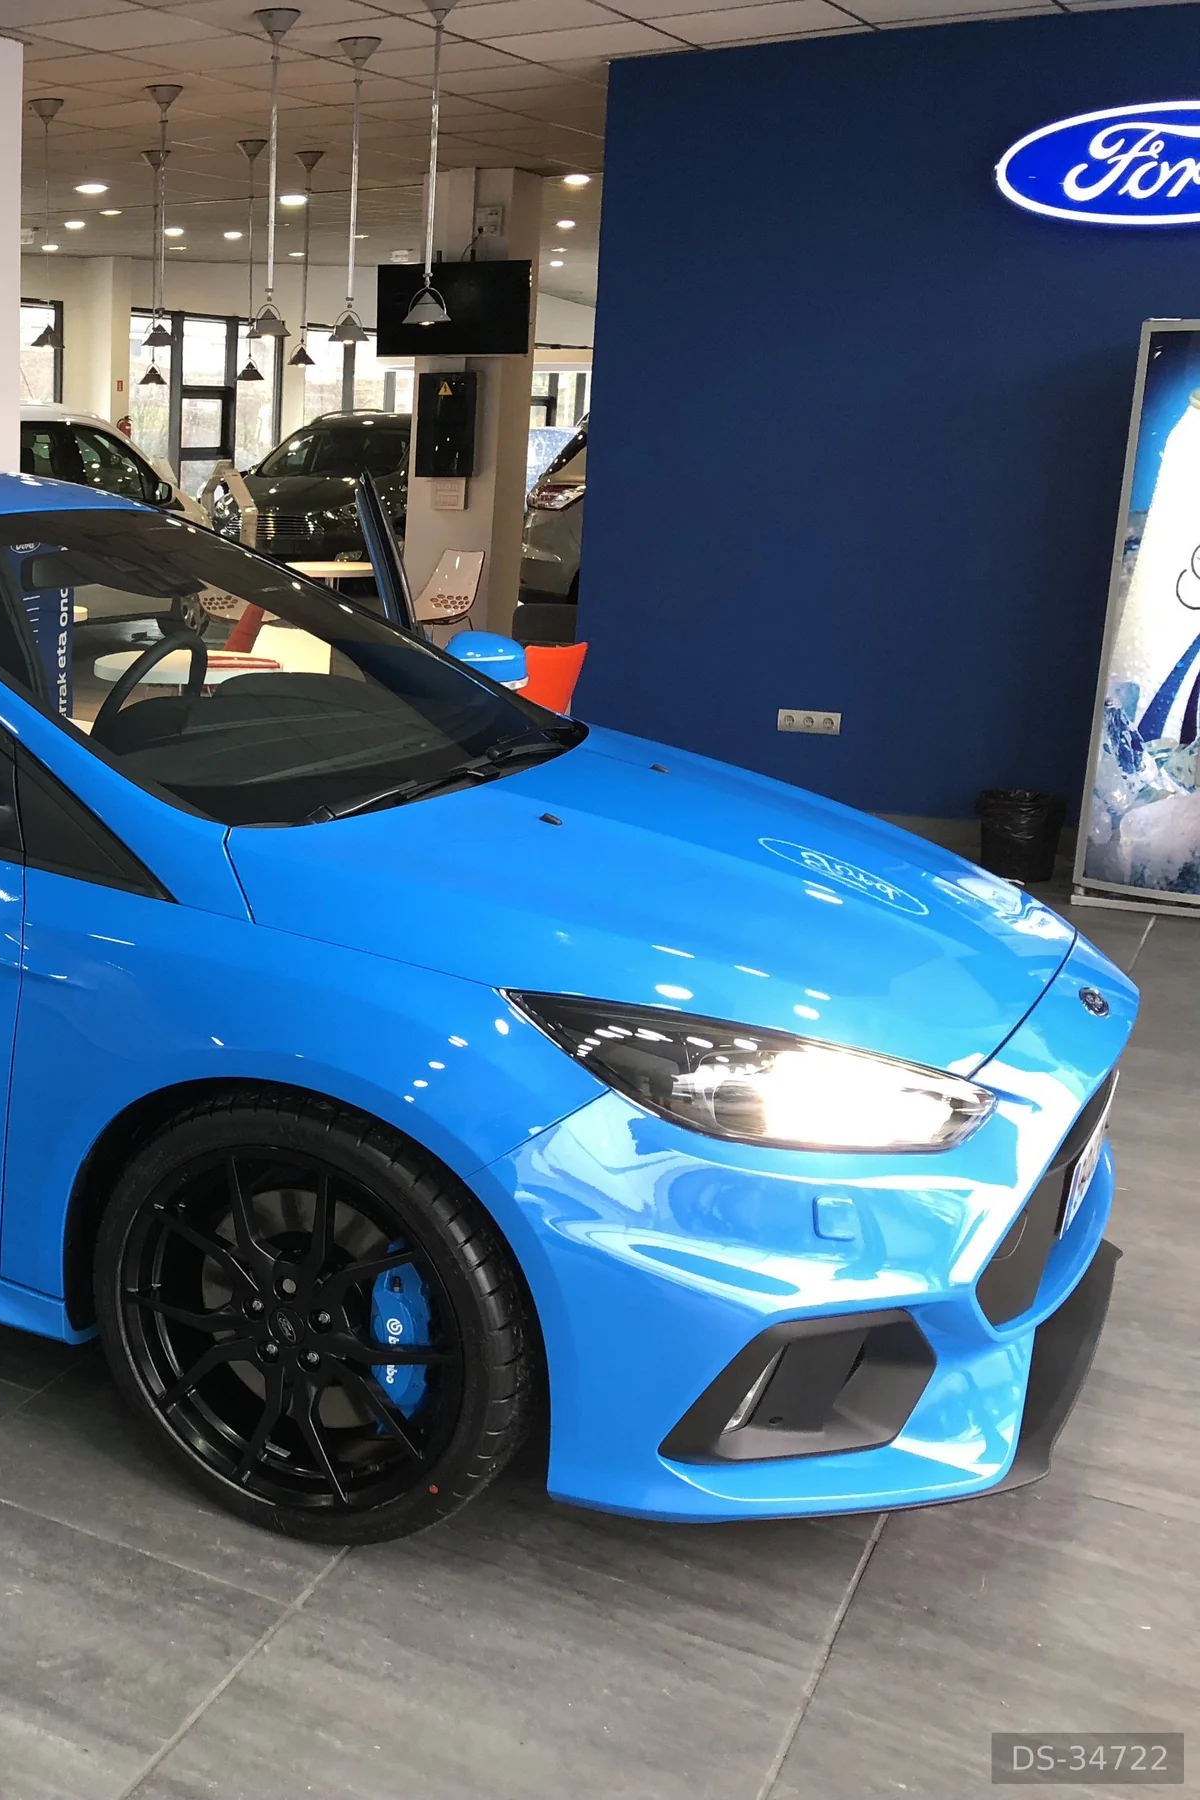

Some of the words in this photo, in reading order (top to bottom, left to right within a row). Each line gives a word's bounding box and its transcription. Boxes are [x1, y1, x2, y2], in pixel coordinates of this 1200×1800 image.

[1062, 121, 1200, 202] For
[56, 630, 68, 669] eta
[57, 672, 67, 718] rrak
[385, 1335, 400, 1385] bbo
